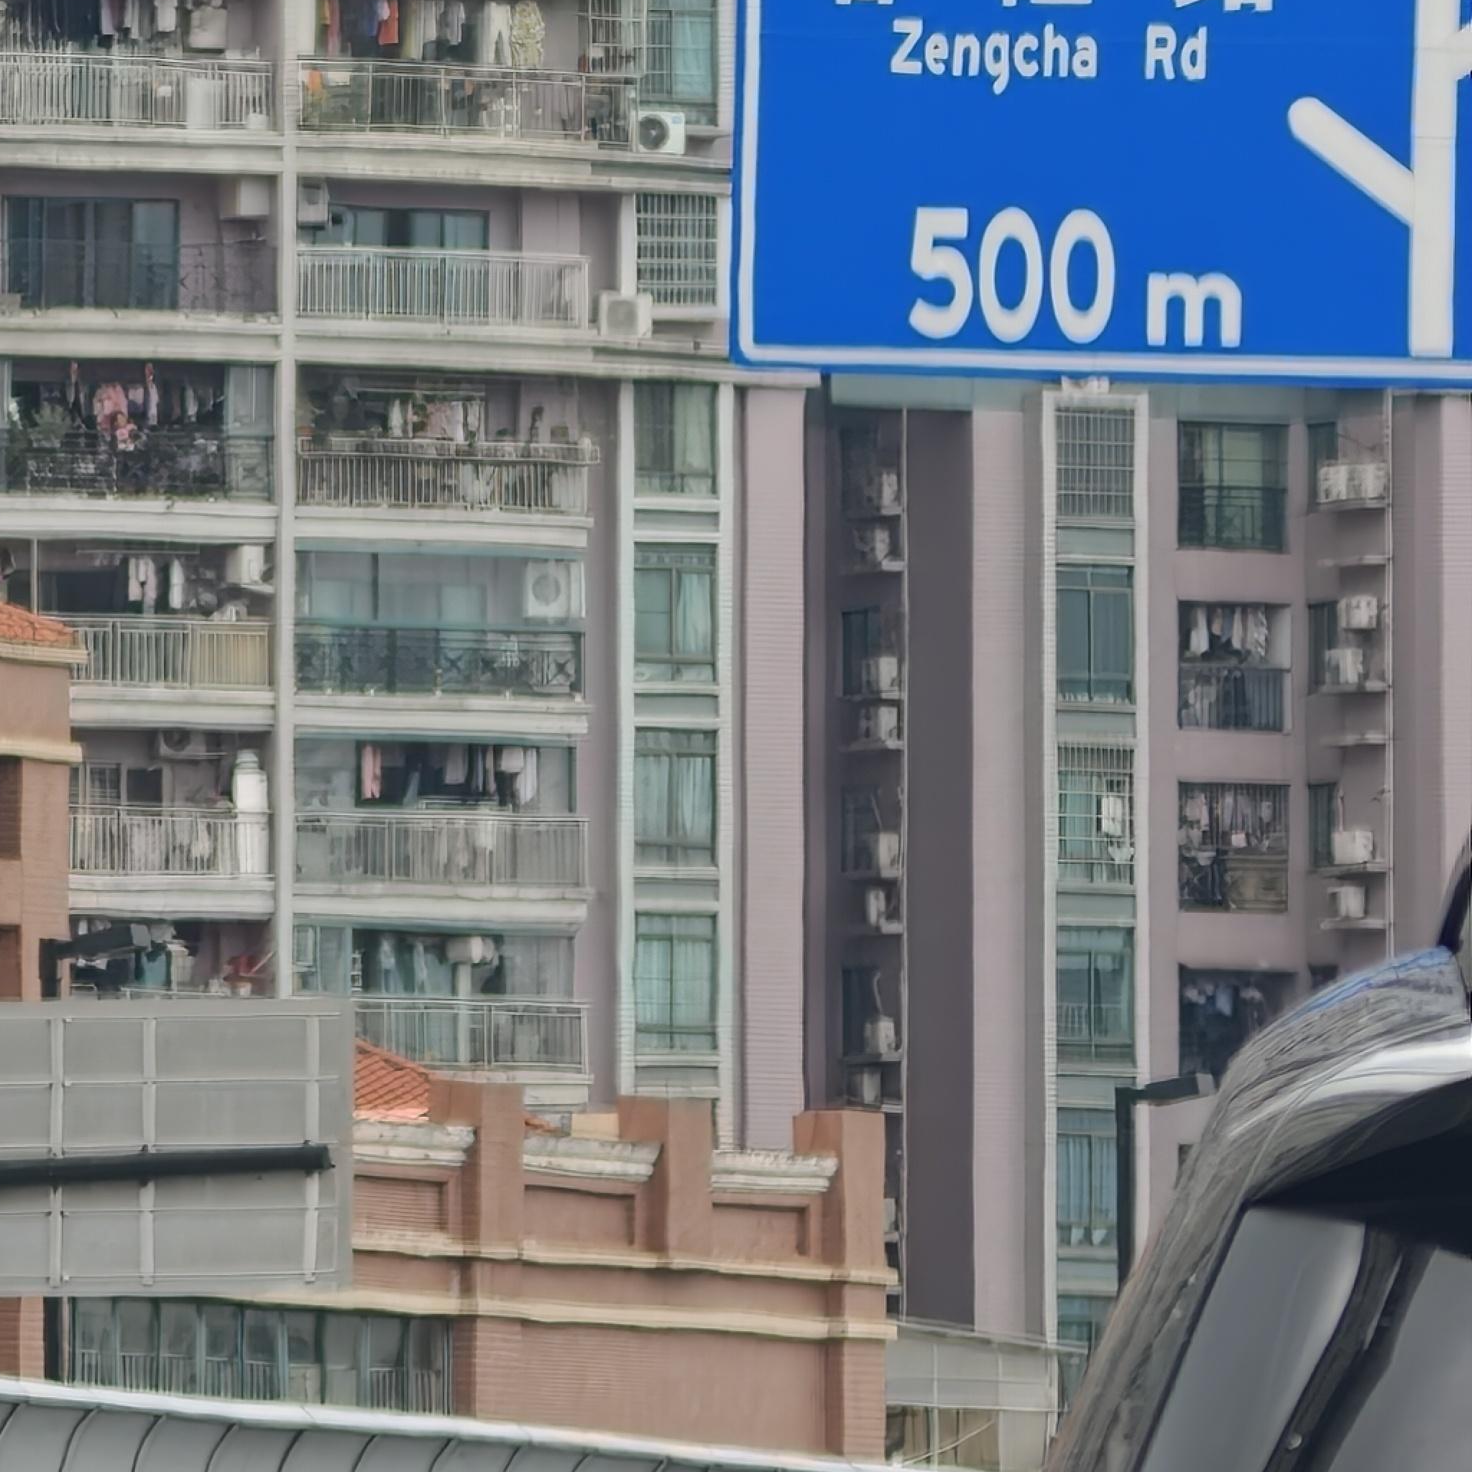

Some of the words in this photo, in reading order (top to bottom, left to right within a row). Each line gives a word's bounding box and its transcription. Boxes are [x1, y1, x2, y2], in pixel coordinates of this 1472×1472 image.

[890, 18, 1098, 94] Zengcha
[1144, 22, 1208, 81] Rd
[909, 206, 1116, 344] 500
[1147, 272, 1243, 348] m
